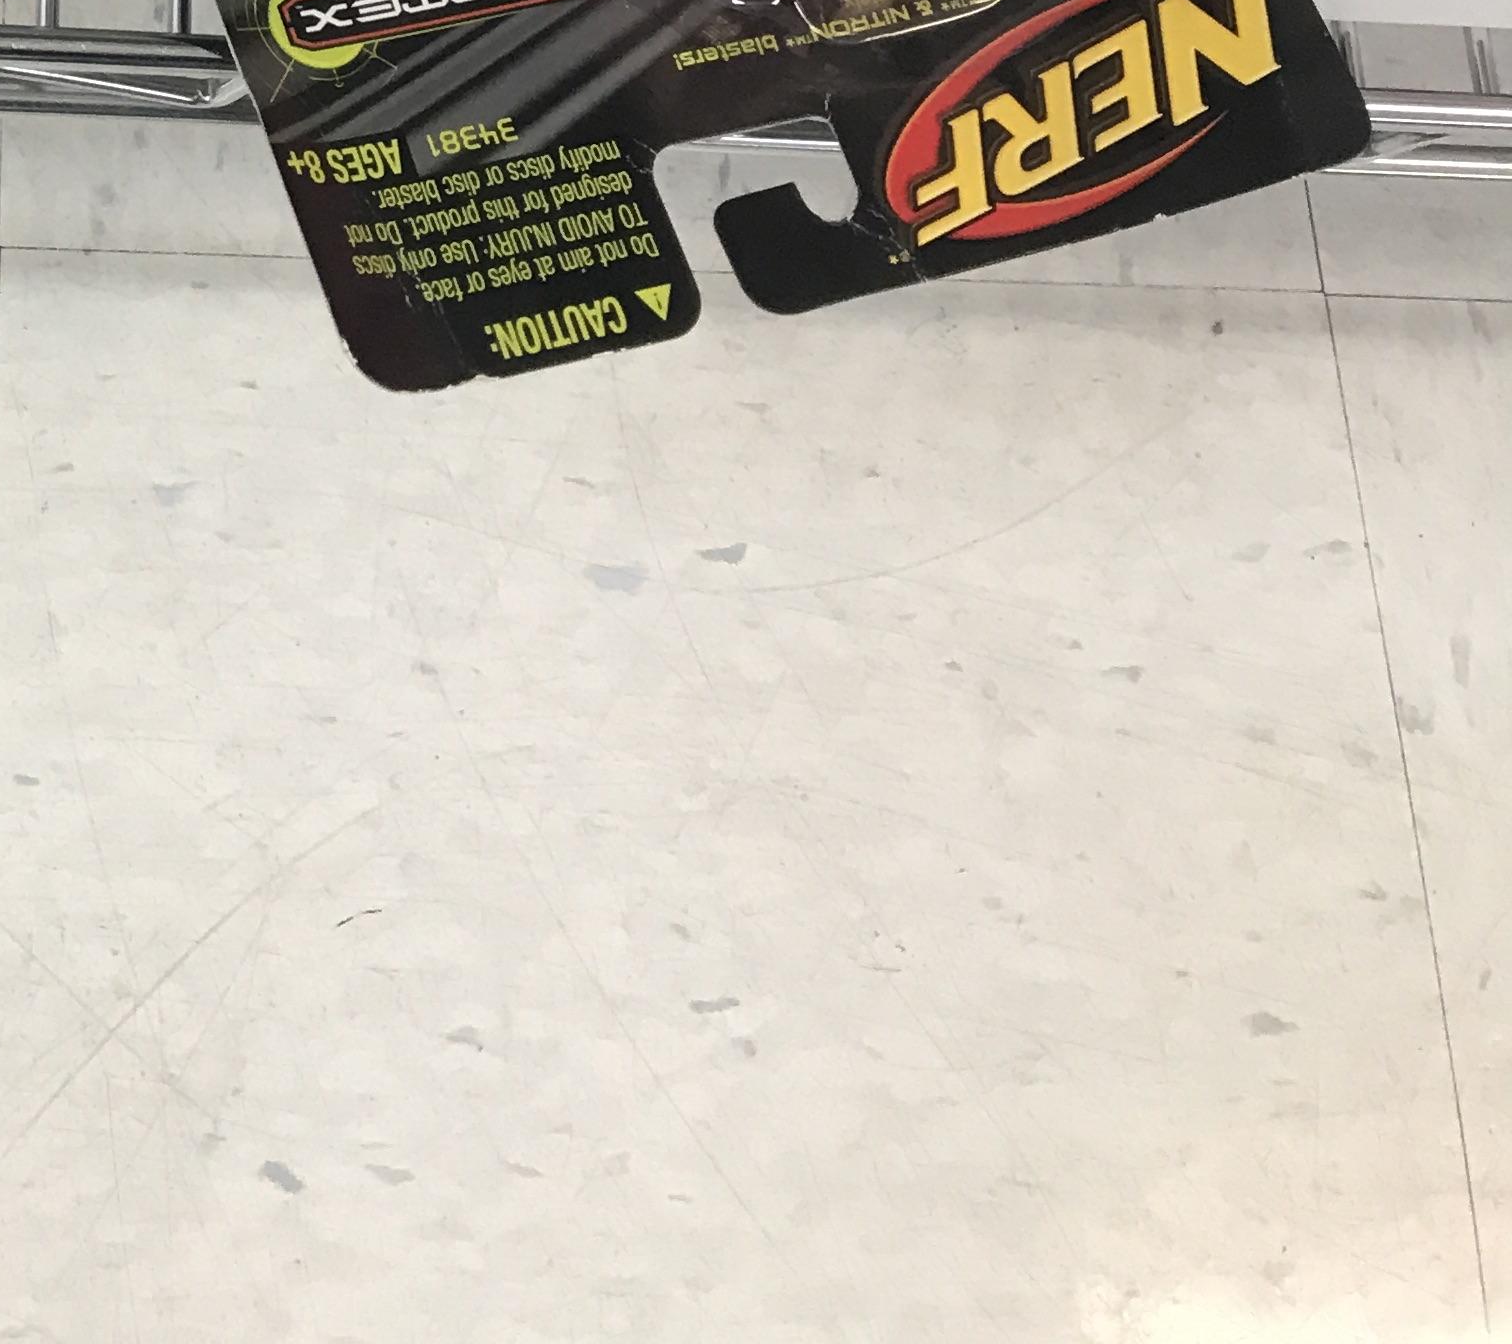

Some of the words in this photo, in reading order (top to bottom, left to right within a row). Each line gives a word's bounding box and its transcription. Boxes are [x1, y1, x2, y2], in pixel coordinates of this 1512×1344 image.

[671, 30, 779, 73] blasters!
[424, 113, 519, 158] 34381
[556, 132, 621, 174] modify
[284, 149, 325, 182] 8+
[324, 137, 404, 186] AGES
[483, 163, 503, 188] or
[505, 150, 557, 186] discs
[370, 176, 440, 215] blaster.
[441, 168, 482, 200] disc
[520, 187, 550, 216] for
[548, 164, 633, 209] designed
[400, 196, 480, 240] product.
[481, 193, 520, 225] this
[556, 206, 616, 243] AVOID
[616, 199, 646, 229] TO
[342, 219, 373, 248] not
[373, 215, 401, 243] Do
[478, 219, 556, 260] INJURY:
[630, 230, 655, 258] Do
[351, 247, 397, 285] discs
[397, 239, 437, 276] only
[439, 237, 477, 268] Use
[485, 252, 532, 288] eyes
[534, 254, 555, 281] at
[556, 245, 595, 278] aim
[594, 237, 628, 269] not
[414, 273, 463, 309] face.
[464, 268, 485, 294] or
[482, 292, 629, 363] CAUTION:
